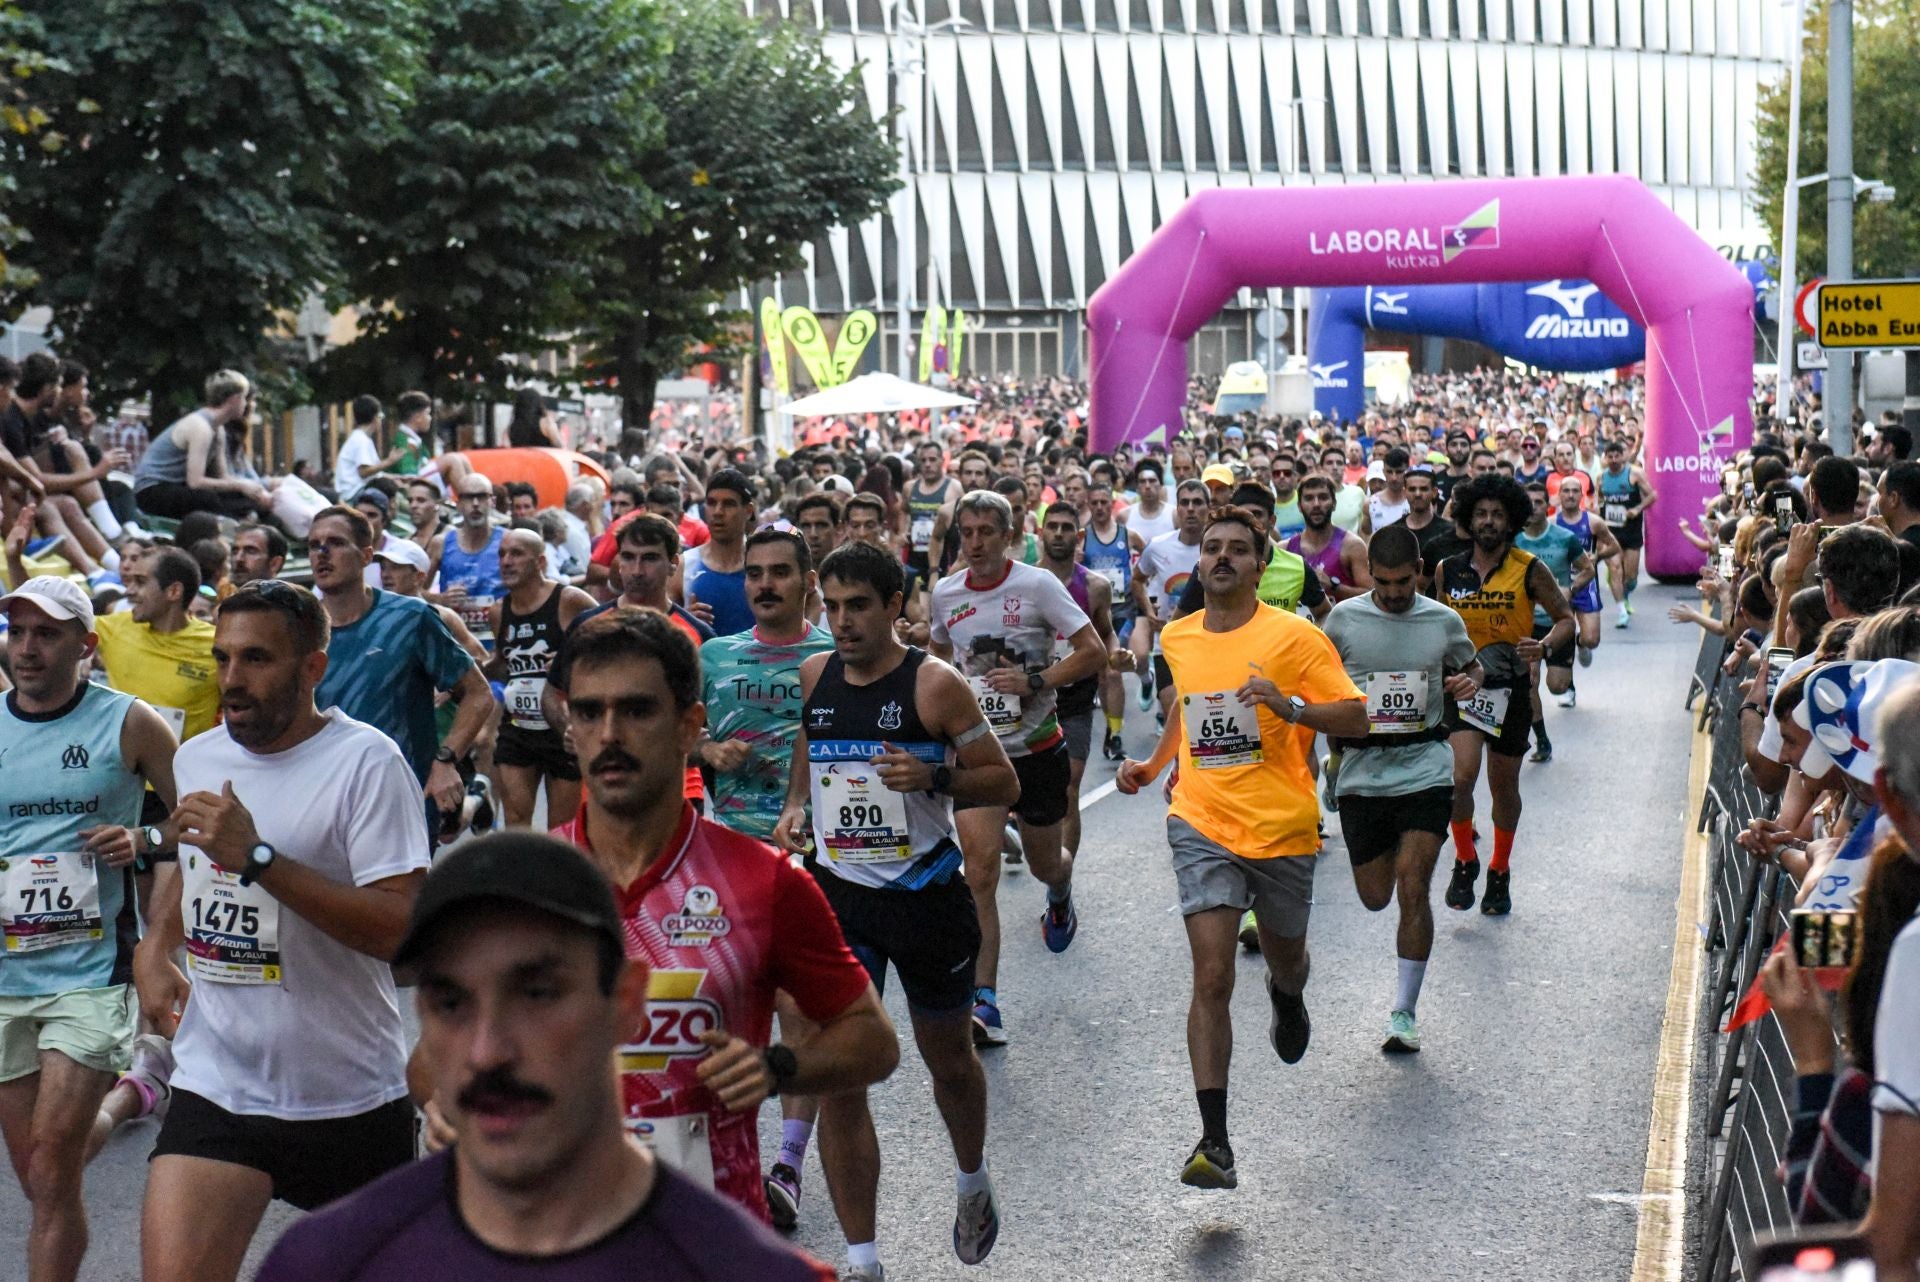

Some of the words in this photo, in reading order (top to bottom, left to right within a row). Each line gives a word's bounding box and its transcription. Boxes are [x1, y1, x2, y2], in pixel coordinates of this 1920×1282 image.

[1309, 227, 1438, 254] LABORAL
[1387, 253, 1440, 269] kutxa
[1824, 295, 1882, 312] Hotel
[1826, 320, 1879, 337] Abba
[1655, 455, 1729, 472] LABORA
[1450, 588, 1515, 601] bichos
[1450, 601, 1515, 609] runners
[1002, 614, 1020, 625] OTSO
[515, 696, 540, 709] 801
[978, 695, 1006, 712] 86
[1381, 692, 1415, 708] 809
[1468, 697, 1494, 714] 335
[1201, 716, 1239, 738] 654
[9, 795, 99, 818] randstad
[839, 804, 883, 828] 890
[20, 885, 74, 913] 716
[213, 888, 234, 899] CYRIL
[192, 897, 259, 936] 1475
[230, 950, 241, 958] LA
[270, 969, 276, 979] 3
